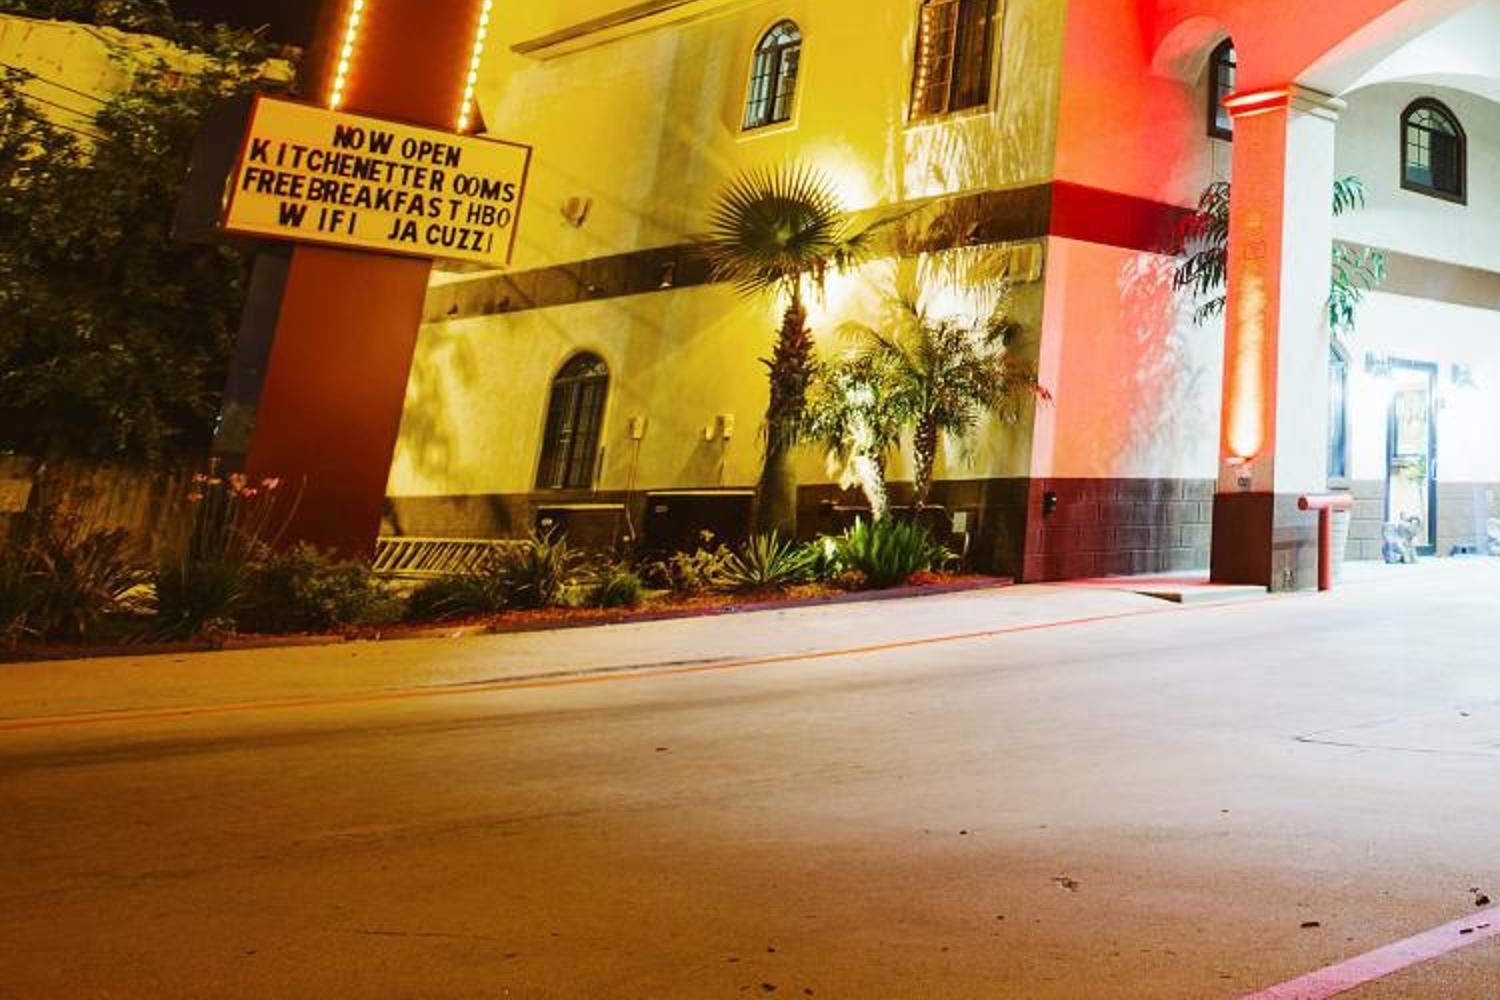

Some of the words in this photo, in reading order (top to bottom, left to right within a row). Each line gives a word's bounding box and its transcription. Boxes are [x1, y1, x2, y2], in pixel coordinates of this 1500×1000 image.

[332, 124, 394, 155] NOW
[401, 138, 462, 168] OPEN
[466, 202, 512, 229] HBO
[387, 218, 494, 253] JACUZZI
